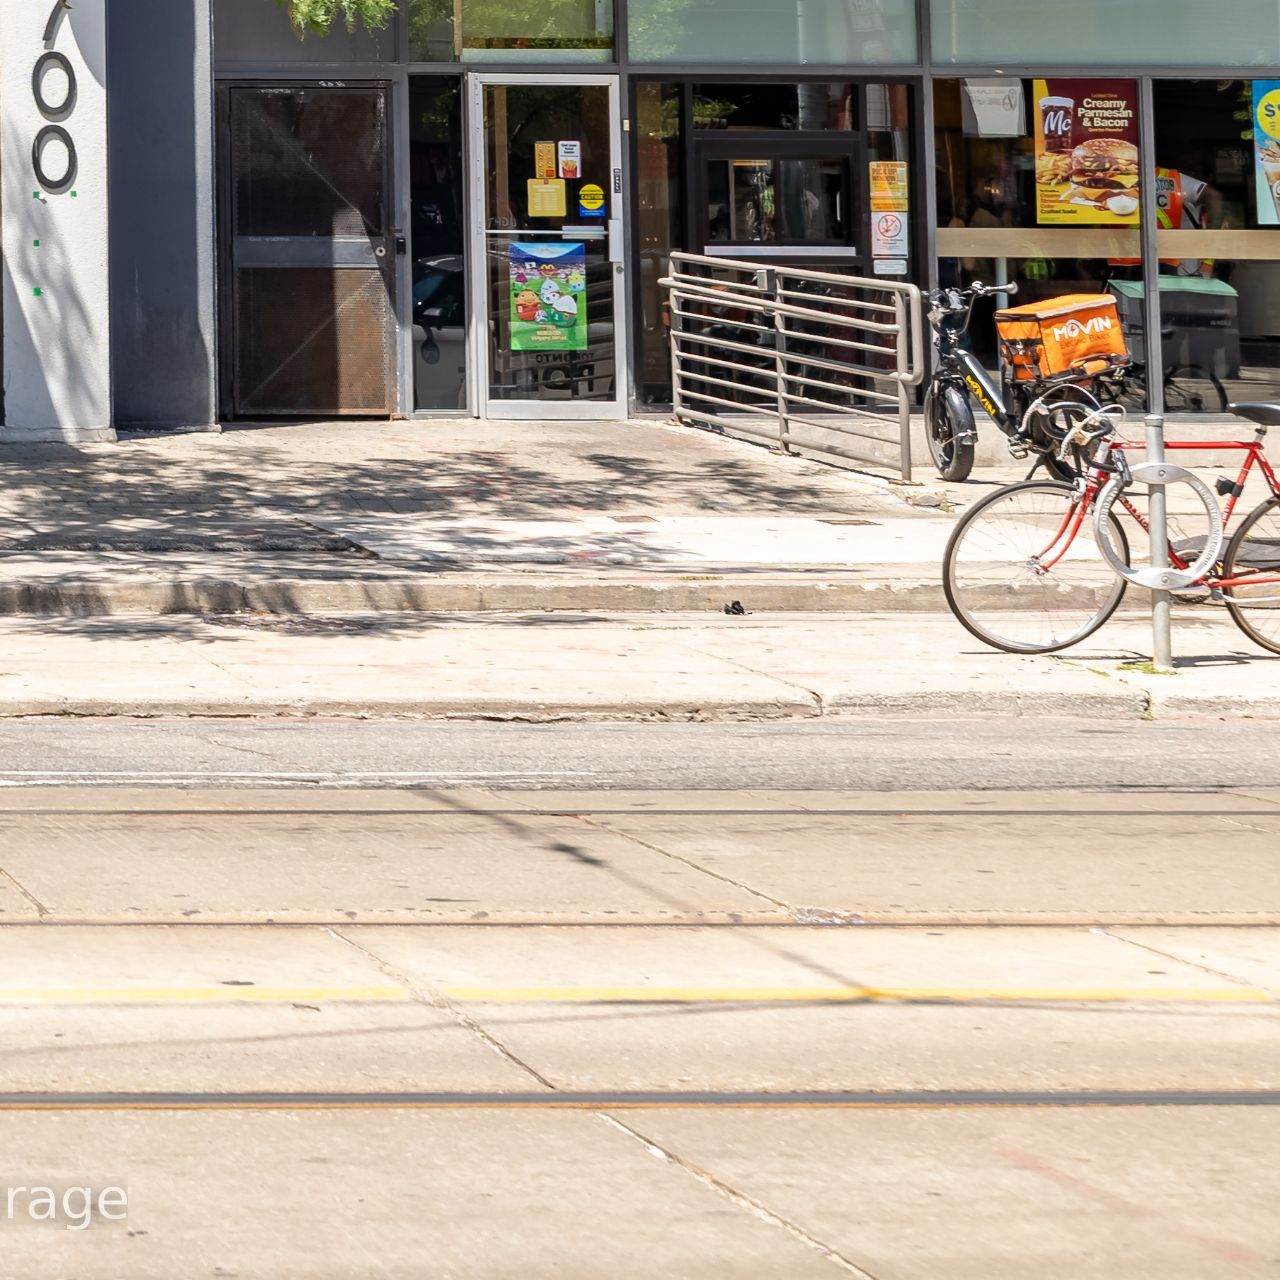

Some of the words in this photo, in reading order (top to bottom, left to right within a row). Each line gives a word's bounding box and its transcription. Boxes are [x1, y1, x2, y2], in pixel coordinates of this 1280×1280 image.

[1082, 98, 1127, 109] Creamy
[1077, 108, 1133, 118] Parmesan
[1044, 110, 1072, 136] Mc
[1082, 118, 1092, 127] &
[1093, 118, 1129, 127] Bacon
[1053, 315, 1112, 342] MOVIN
